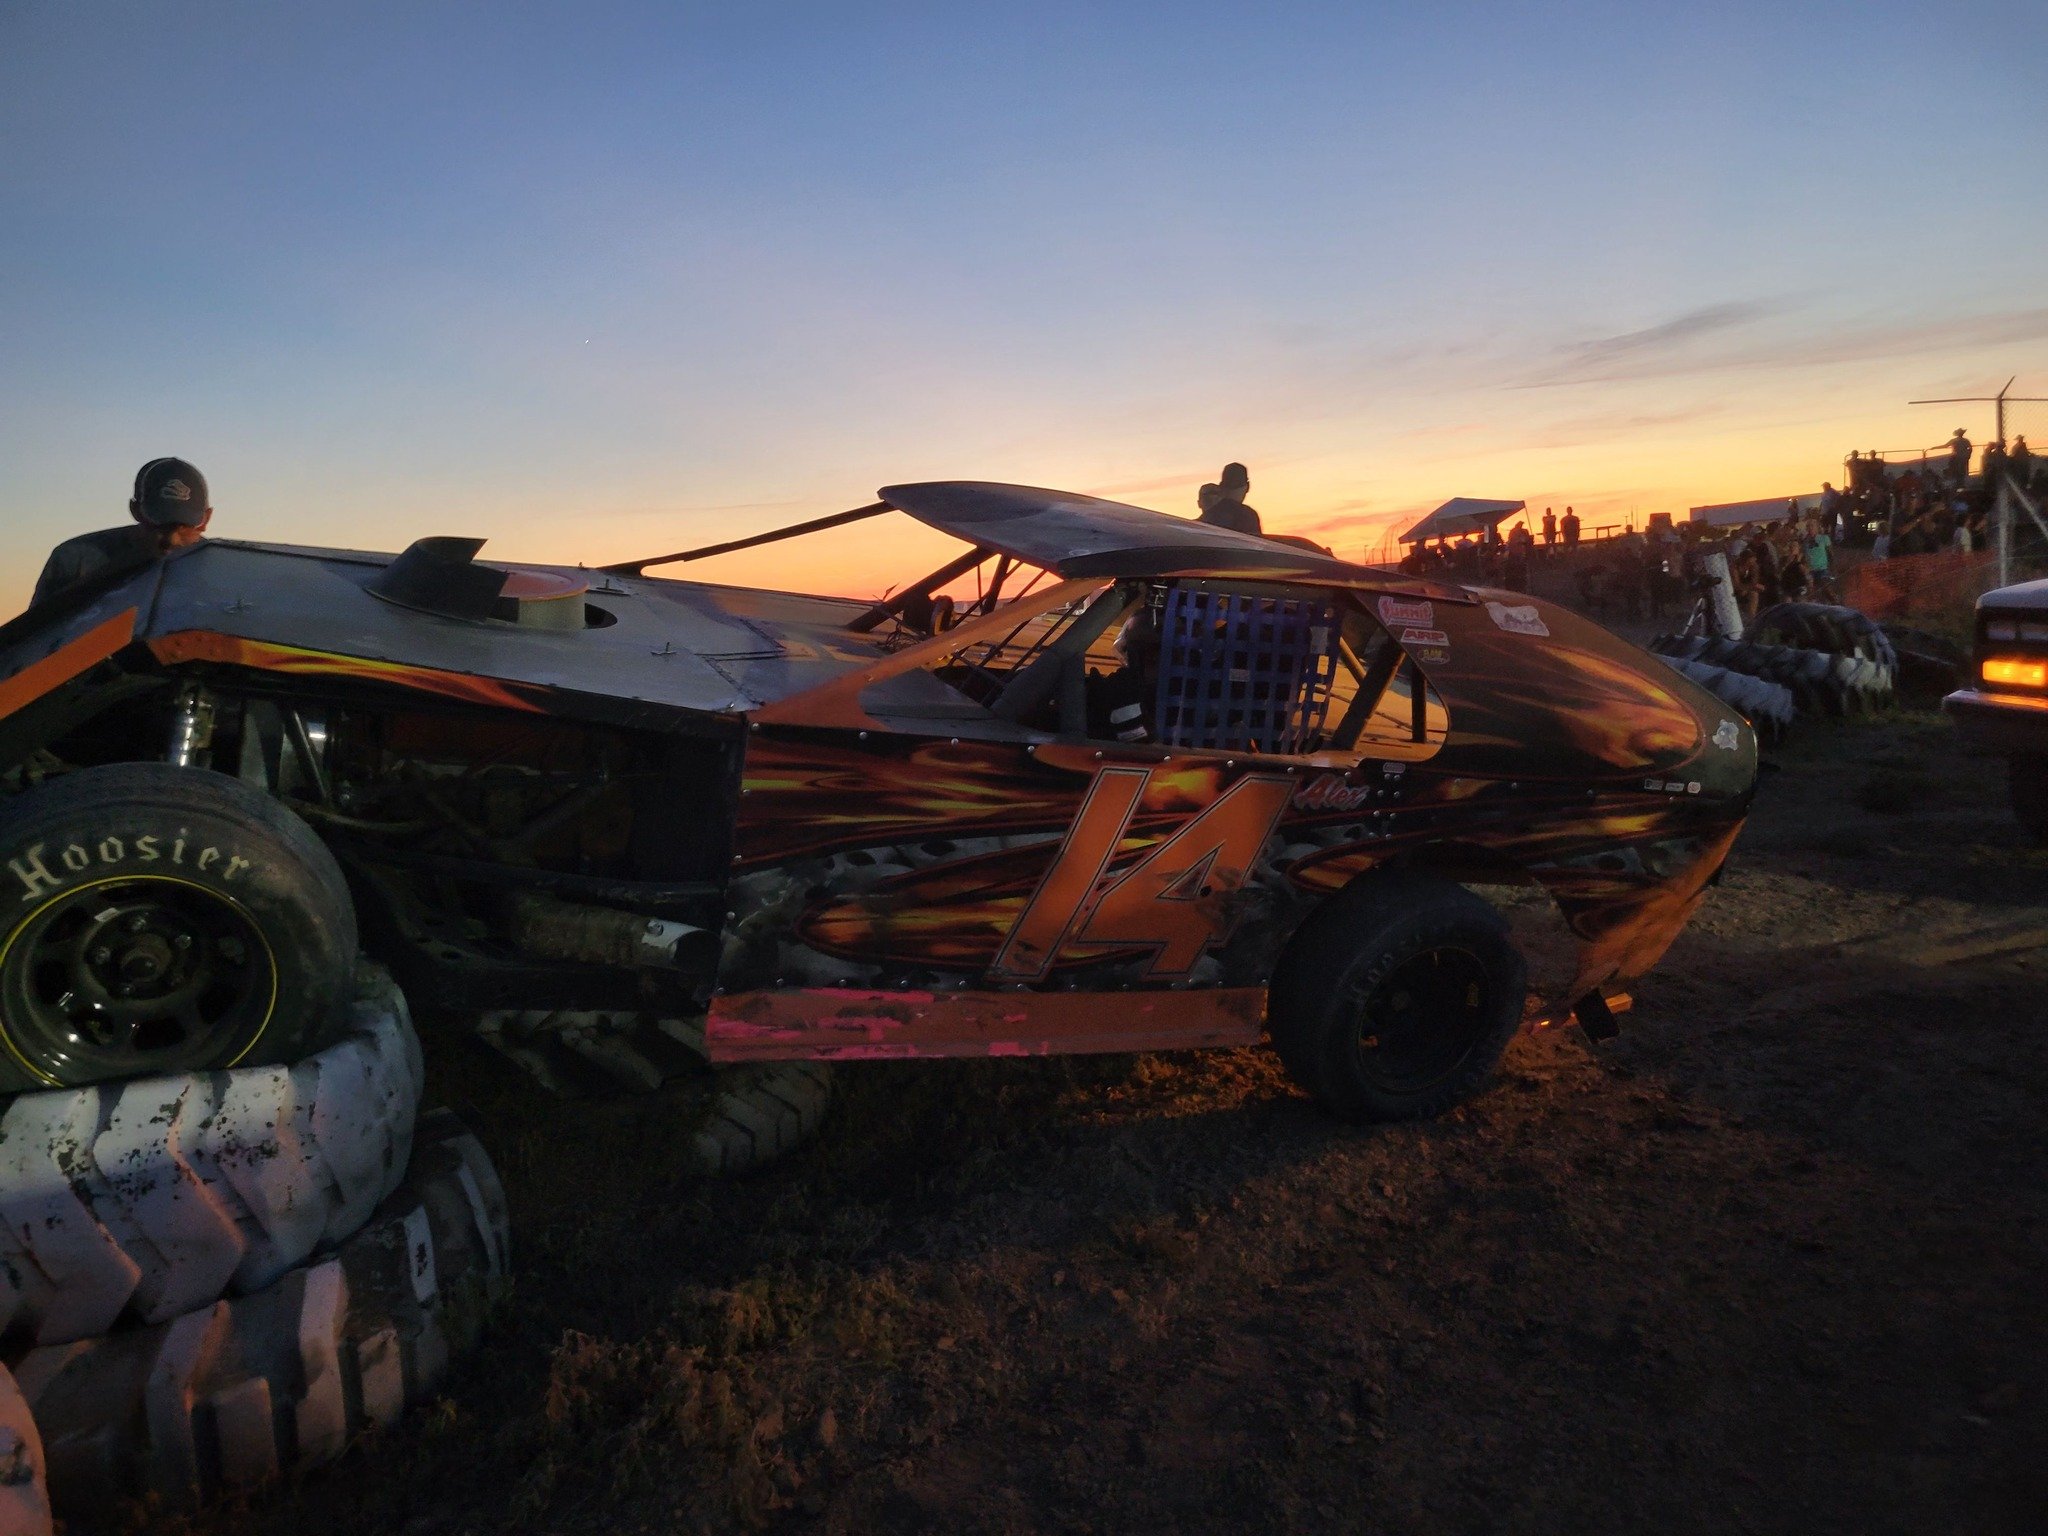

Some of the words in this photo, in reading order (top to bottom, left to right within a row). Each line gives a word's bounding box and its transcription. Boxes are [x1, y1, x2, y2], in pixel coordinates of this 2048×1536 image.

[1294, 773, 1370, 811] Alex
[8, 827, 249, 901] Hoosier
[984, 766, 1297, 982] 14
